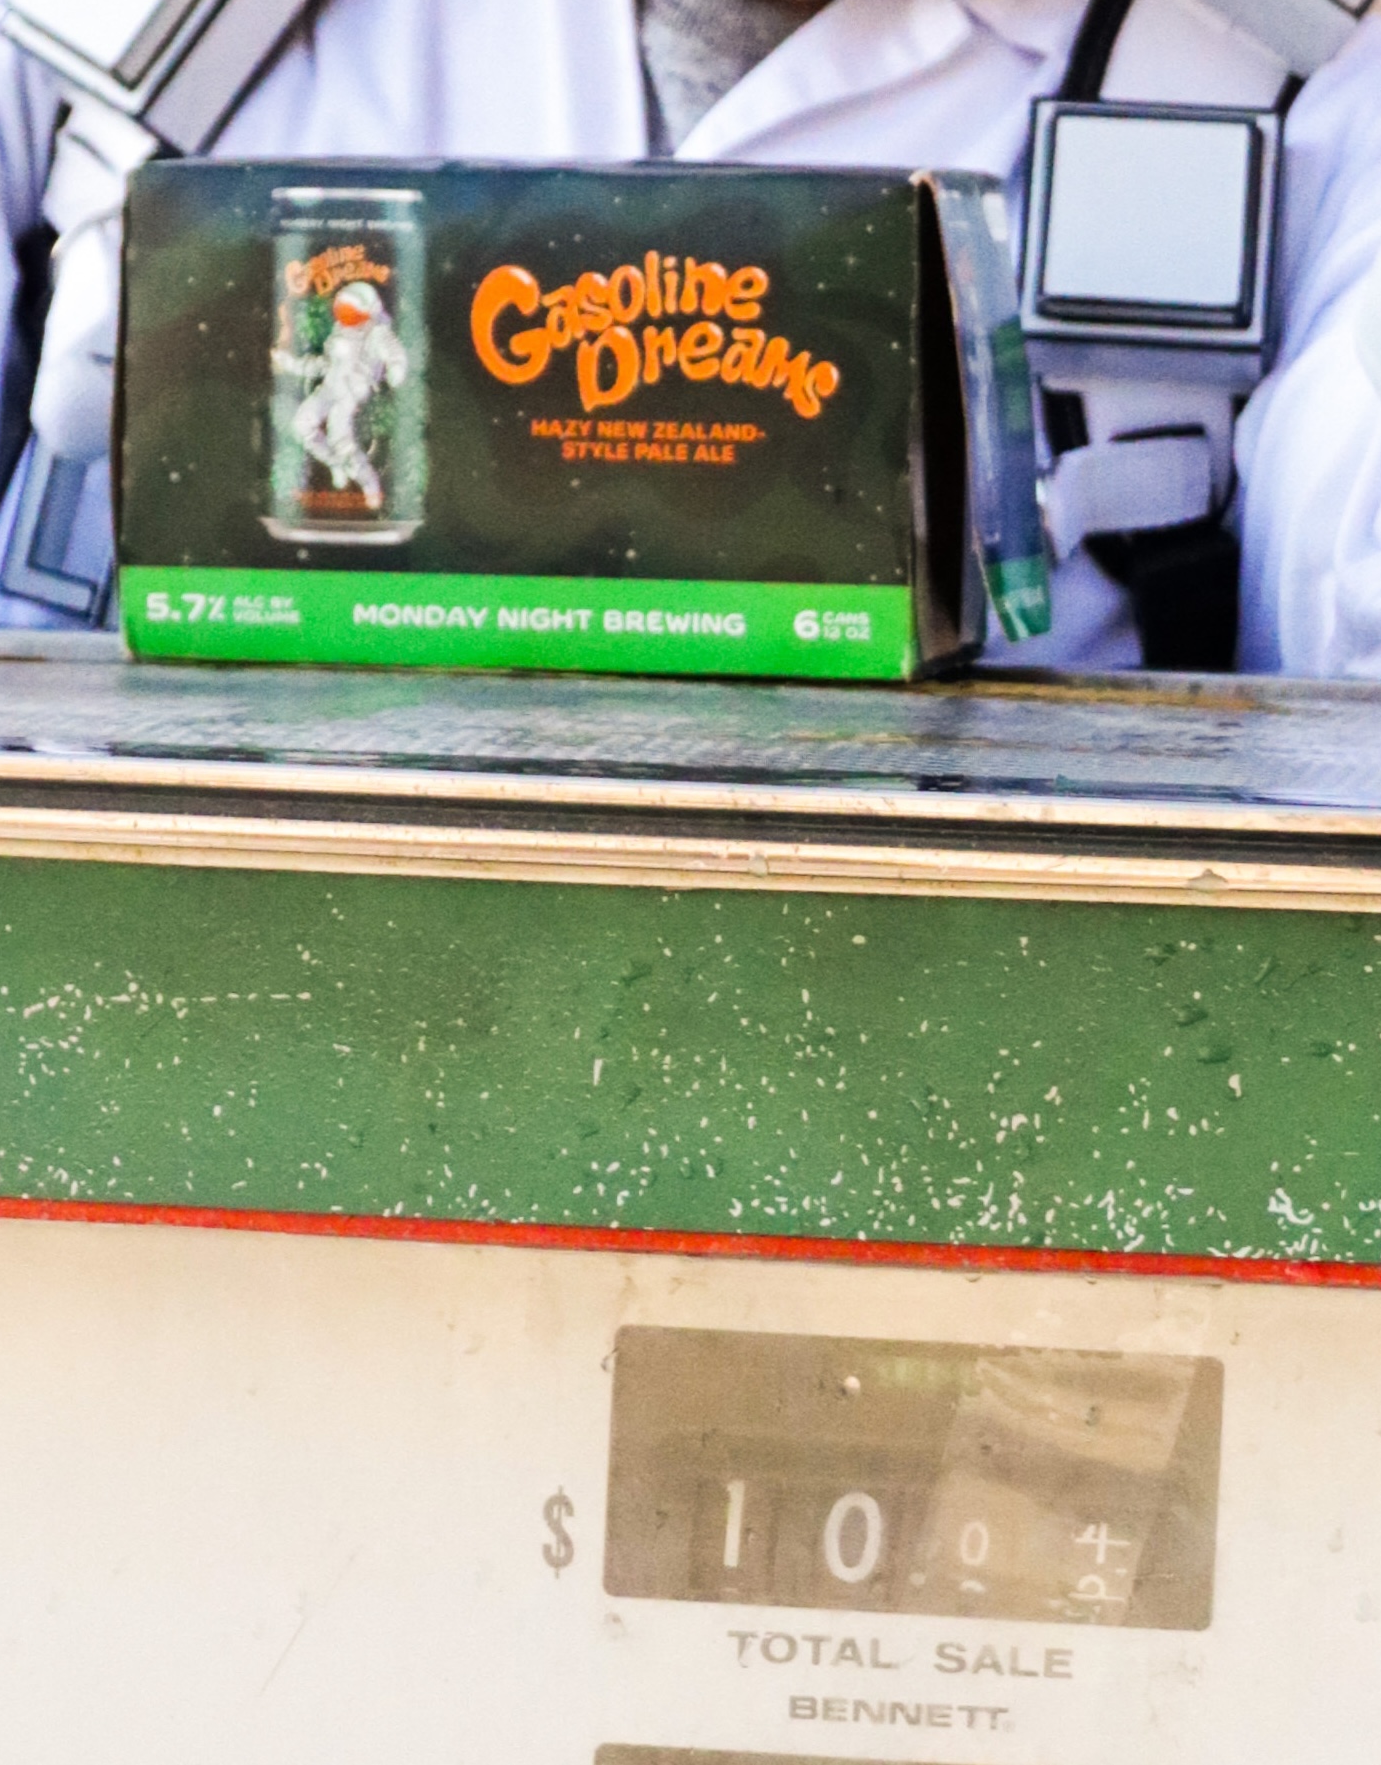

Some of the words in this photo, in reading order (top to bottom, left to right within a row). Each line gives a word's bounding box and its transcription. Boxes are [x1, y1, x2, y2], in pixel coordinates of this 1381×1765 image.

[470, 250, 769, 384] Gasoline
[577, 321, 839, 419] Dreams
[531, 418, 593, 439] HAZY
[596, 420, 648, 441] NEW
[652, 421, 766, 443] ZEALAND-
[562, 441, 629, 462] STYLE
[634, 442, 688, 462] PALE
[693, 444, 736, 464] ALE
[146, 592, 226, 623] 5.7%
[353, 603, 489, 629] MONDAY
[497, 607, 593, 632] NIGHT
[603, 609, 747, 636] BREWING
[793, 609, 820, 640] 6
[541, 1485, 575, 1580] $
[727, 1630, 902, 1670] TOTAL
[933, 1641, 1075, 1679] SALE
[788, 1695, 1010, 1730] BENNETT
